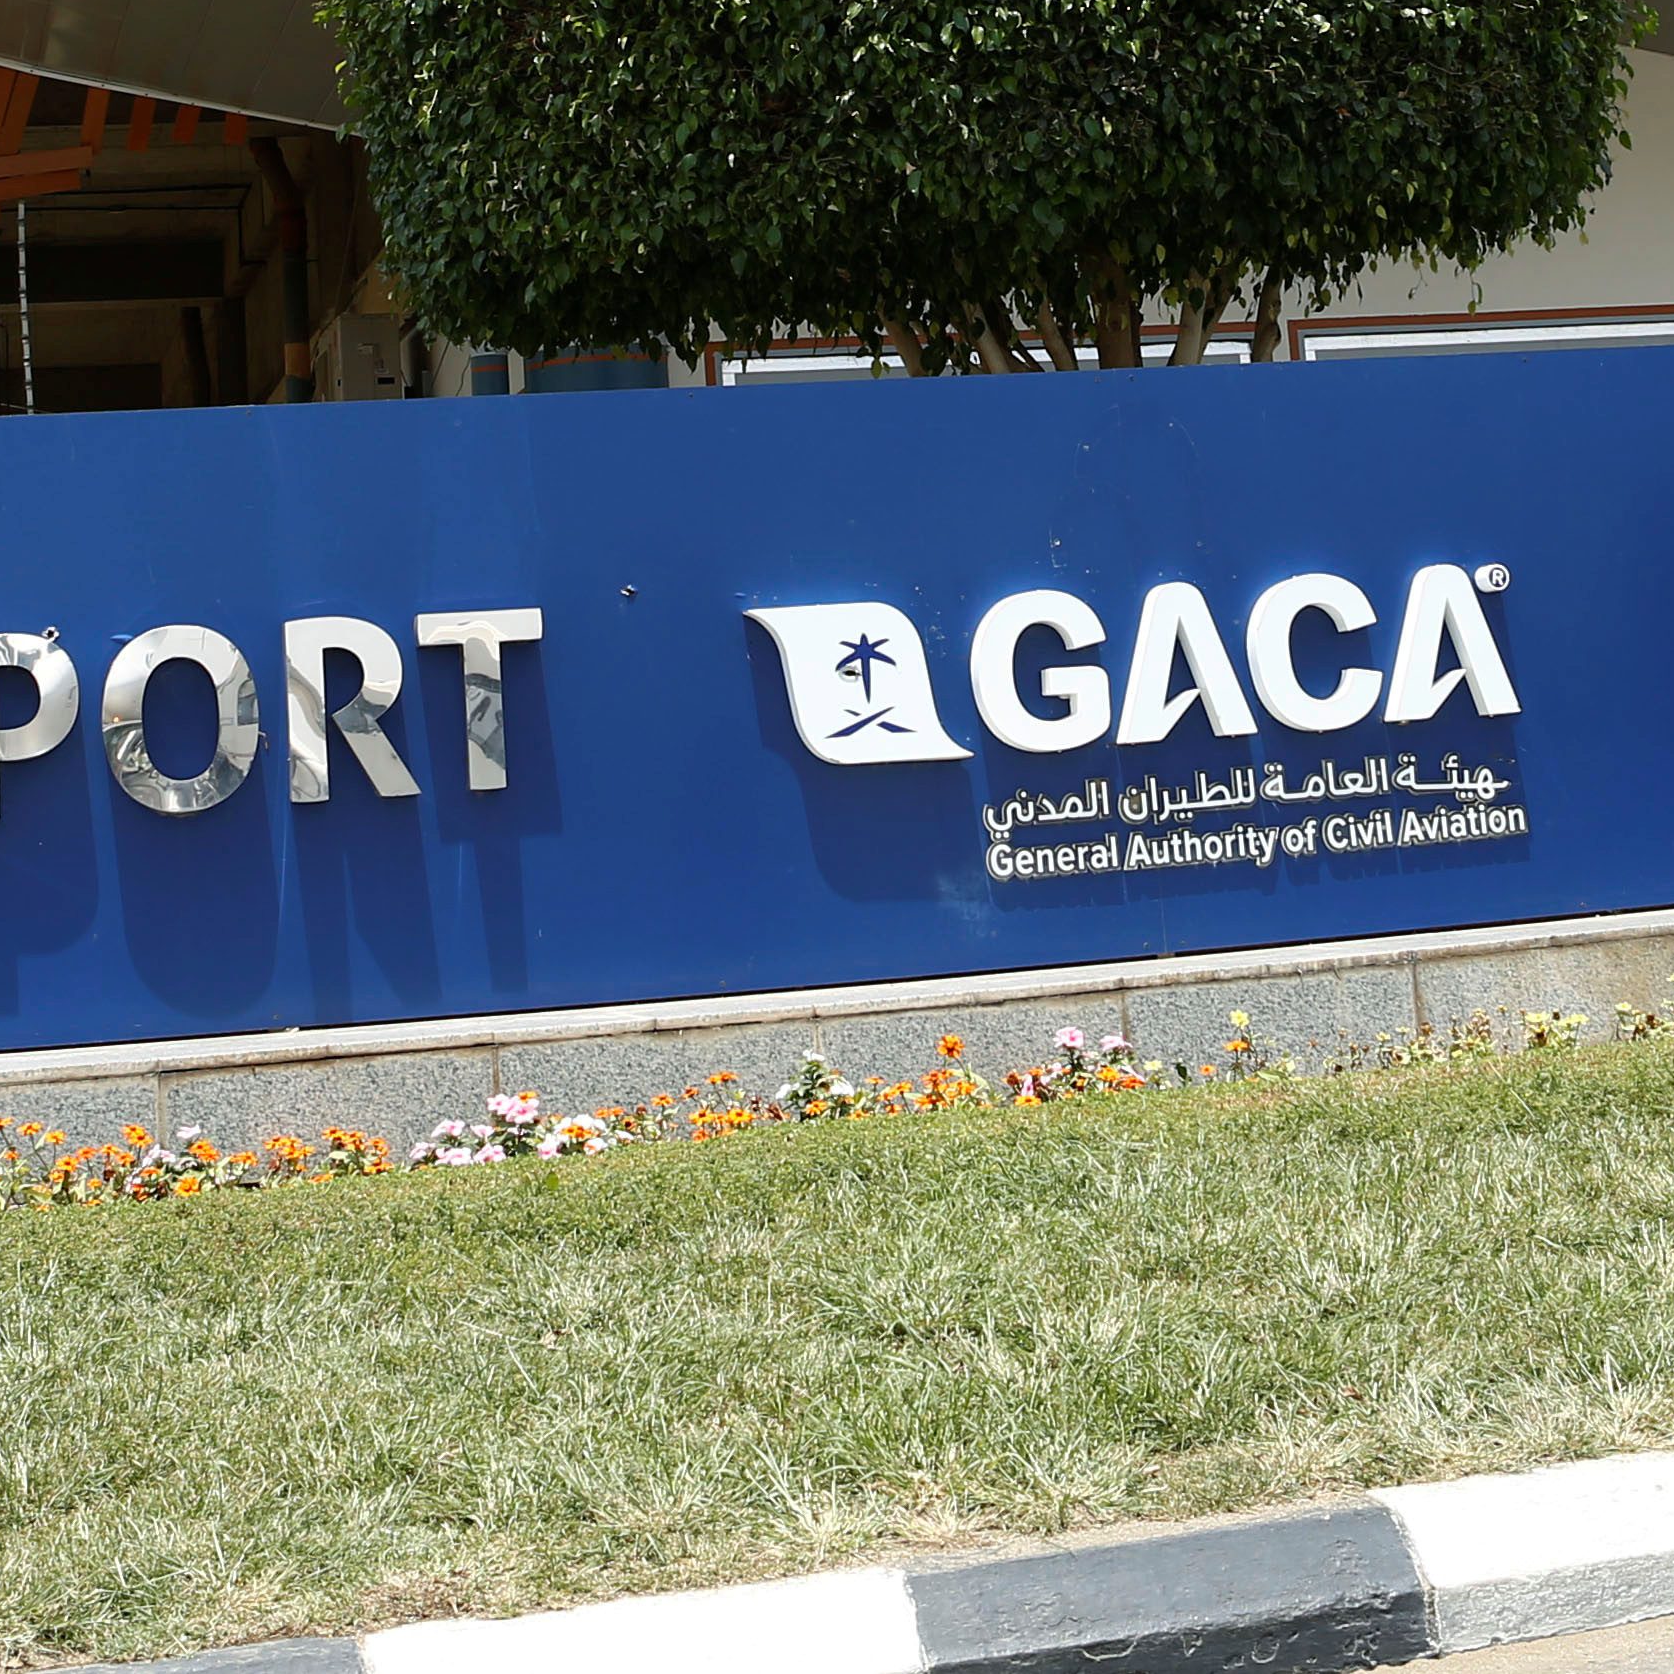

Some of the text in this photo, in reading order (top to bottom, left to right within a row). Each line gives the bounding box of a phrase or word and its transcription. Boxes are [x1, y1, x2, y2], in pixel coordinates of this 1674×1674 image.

[1119, 767, 1256, 824] للطيران
[1260, 757, 1390, 802] العامة
[983, 779, 1111, 841] المدني
[986, 802, 1529, 881] General Authority of Civil Aviation
